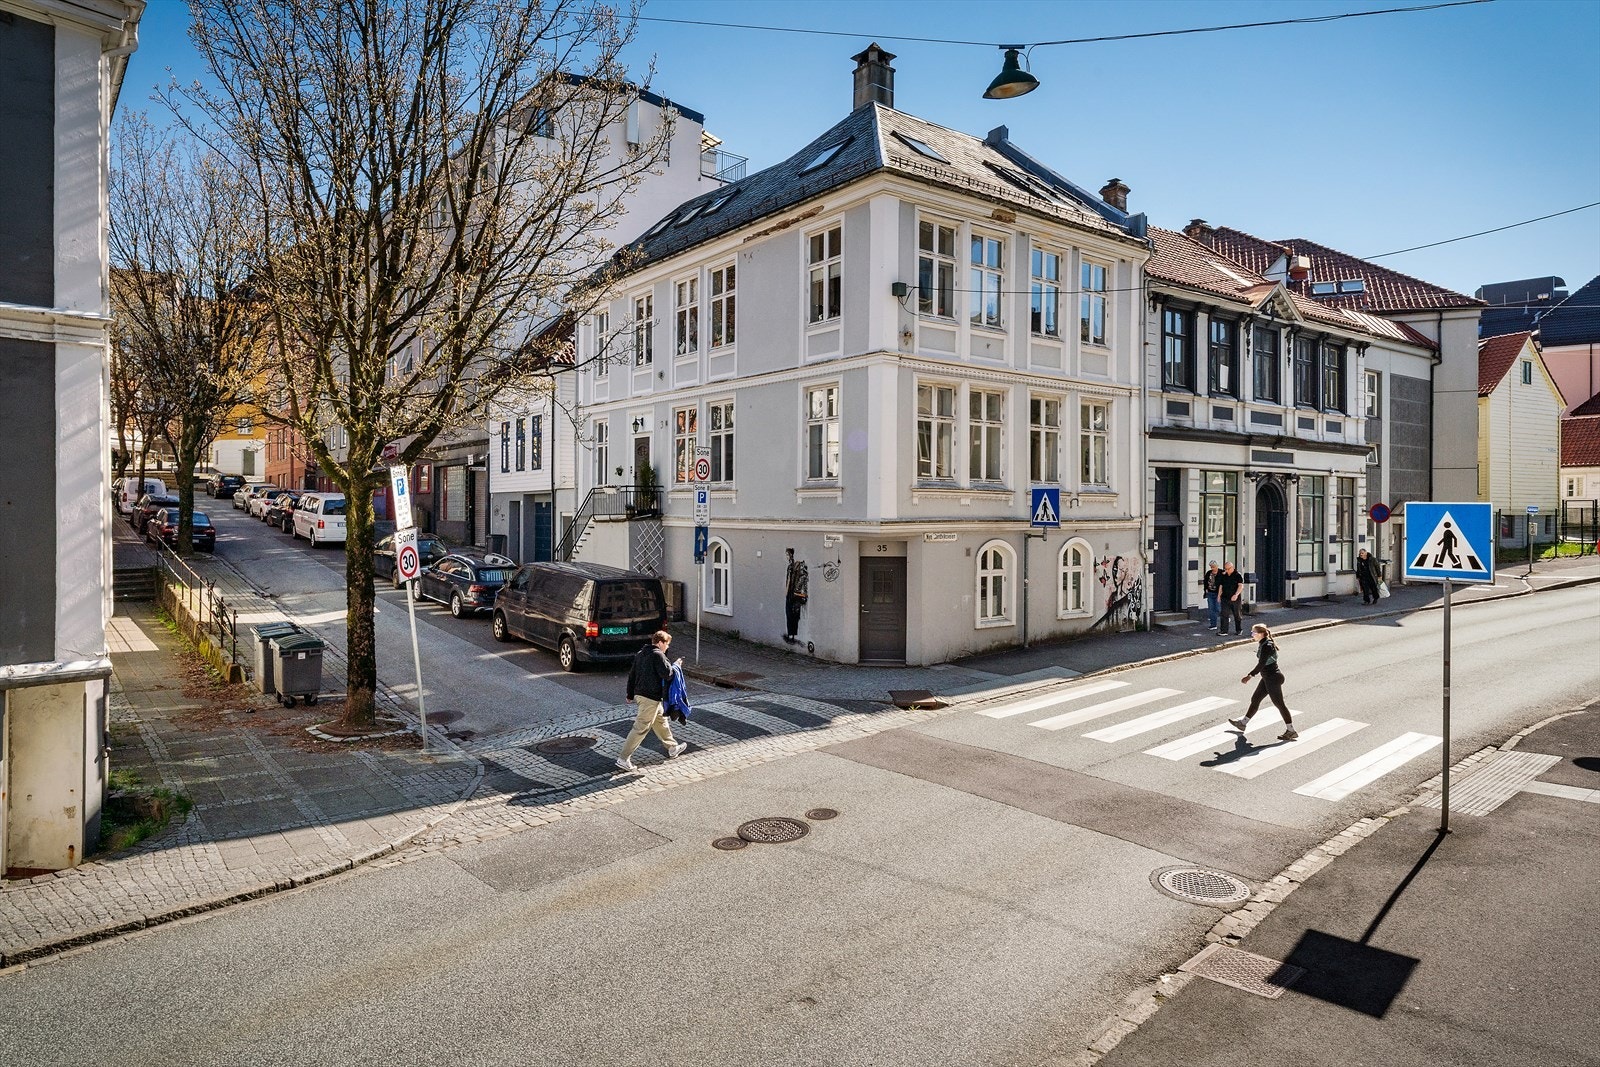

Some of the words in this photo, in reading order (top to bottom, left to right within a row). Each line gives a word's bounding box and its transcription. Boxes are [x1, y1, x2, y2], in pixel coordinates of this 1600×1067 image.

[697, 448, 710, 456] Sone
[698, 464, 708, 475] 30
[398, 533, 415, 544] Sone
[877, 544, 888, 552] 35
[402, 553, 415, 570] 30
